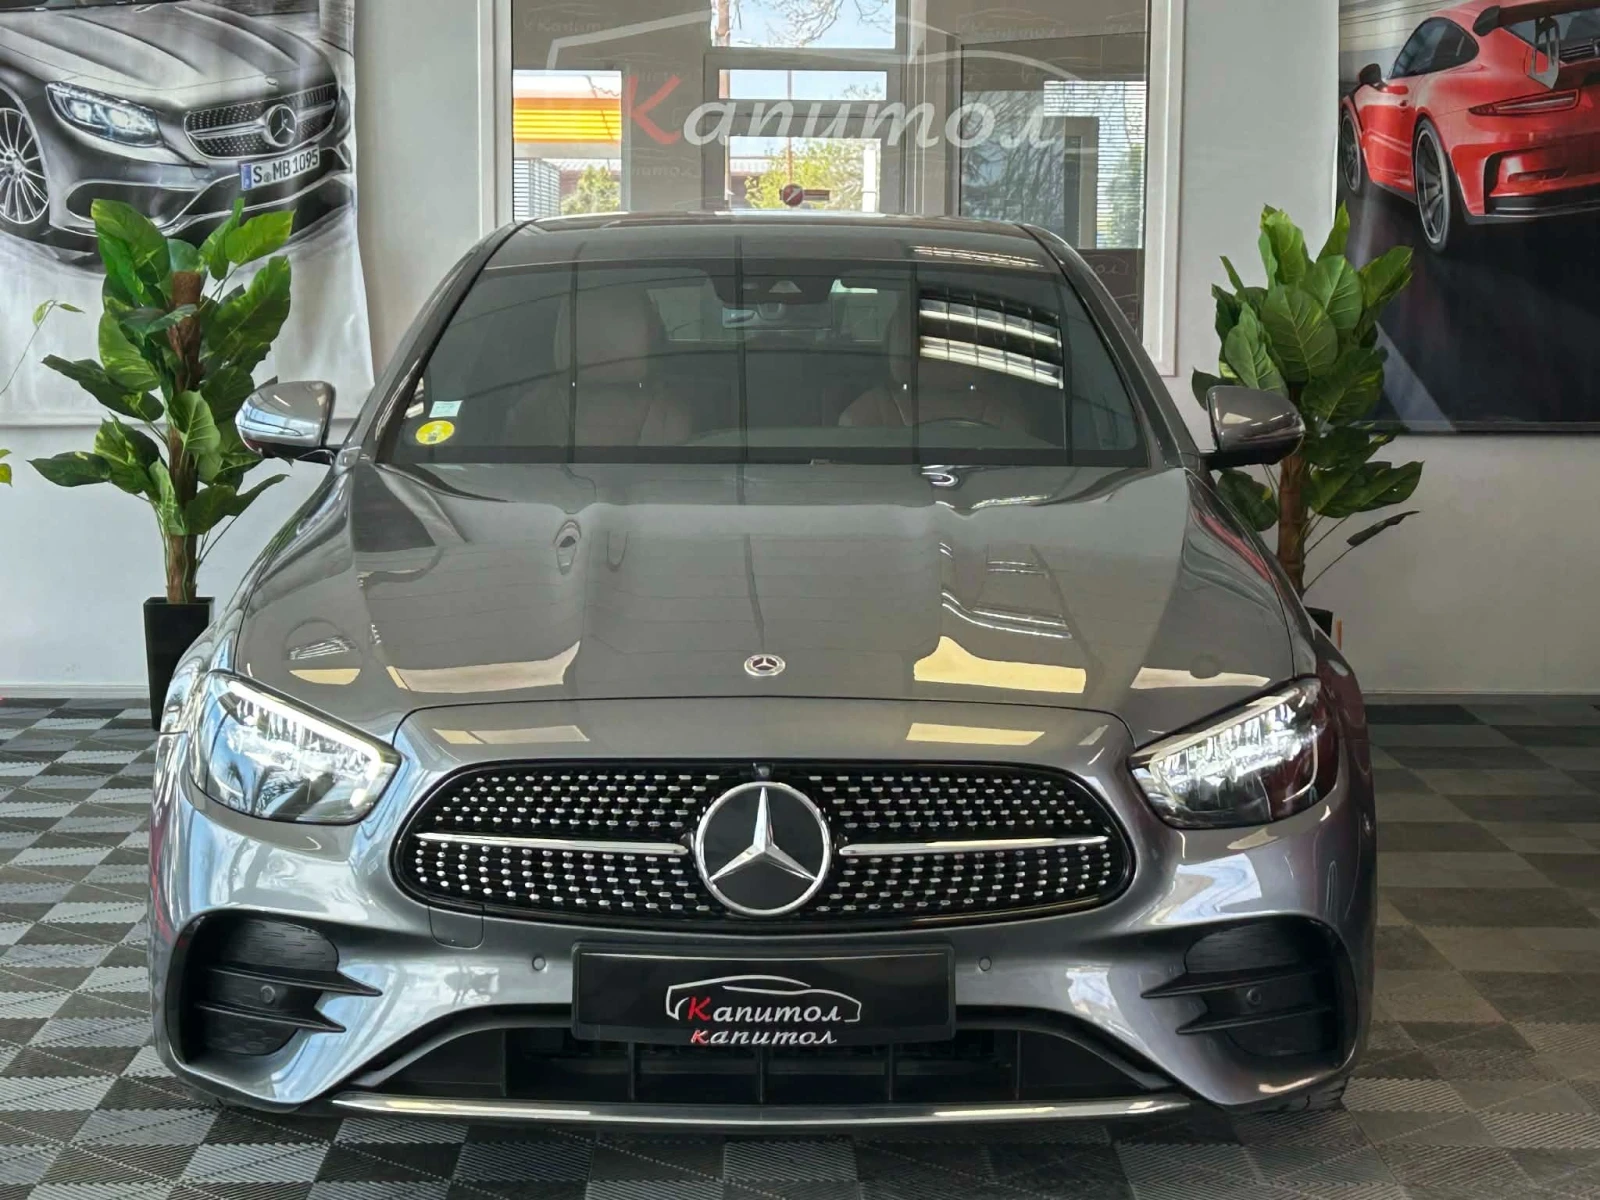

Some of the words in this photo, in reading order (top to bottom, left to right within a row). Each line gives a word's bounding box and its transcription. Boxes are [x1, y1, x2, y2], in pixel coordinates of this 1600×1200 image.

[623, 74, 1057, 148] Капитол
[253, 165, 263, 184] S
[687, 995, 842, 1022] Капитол
